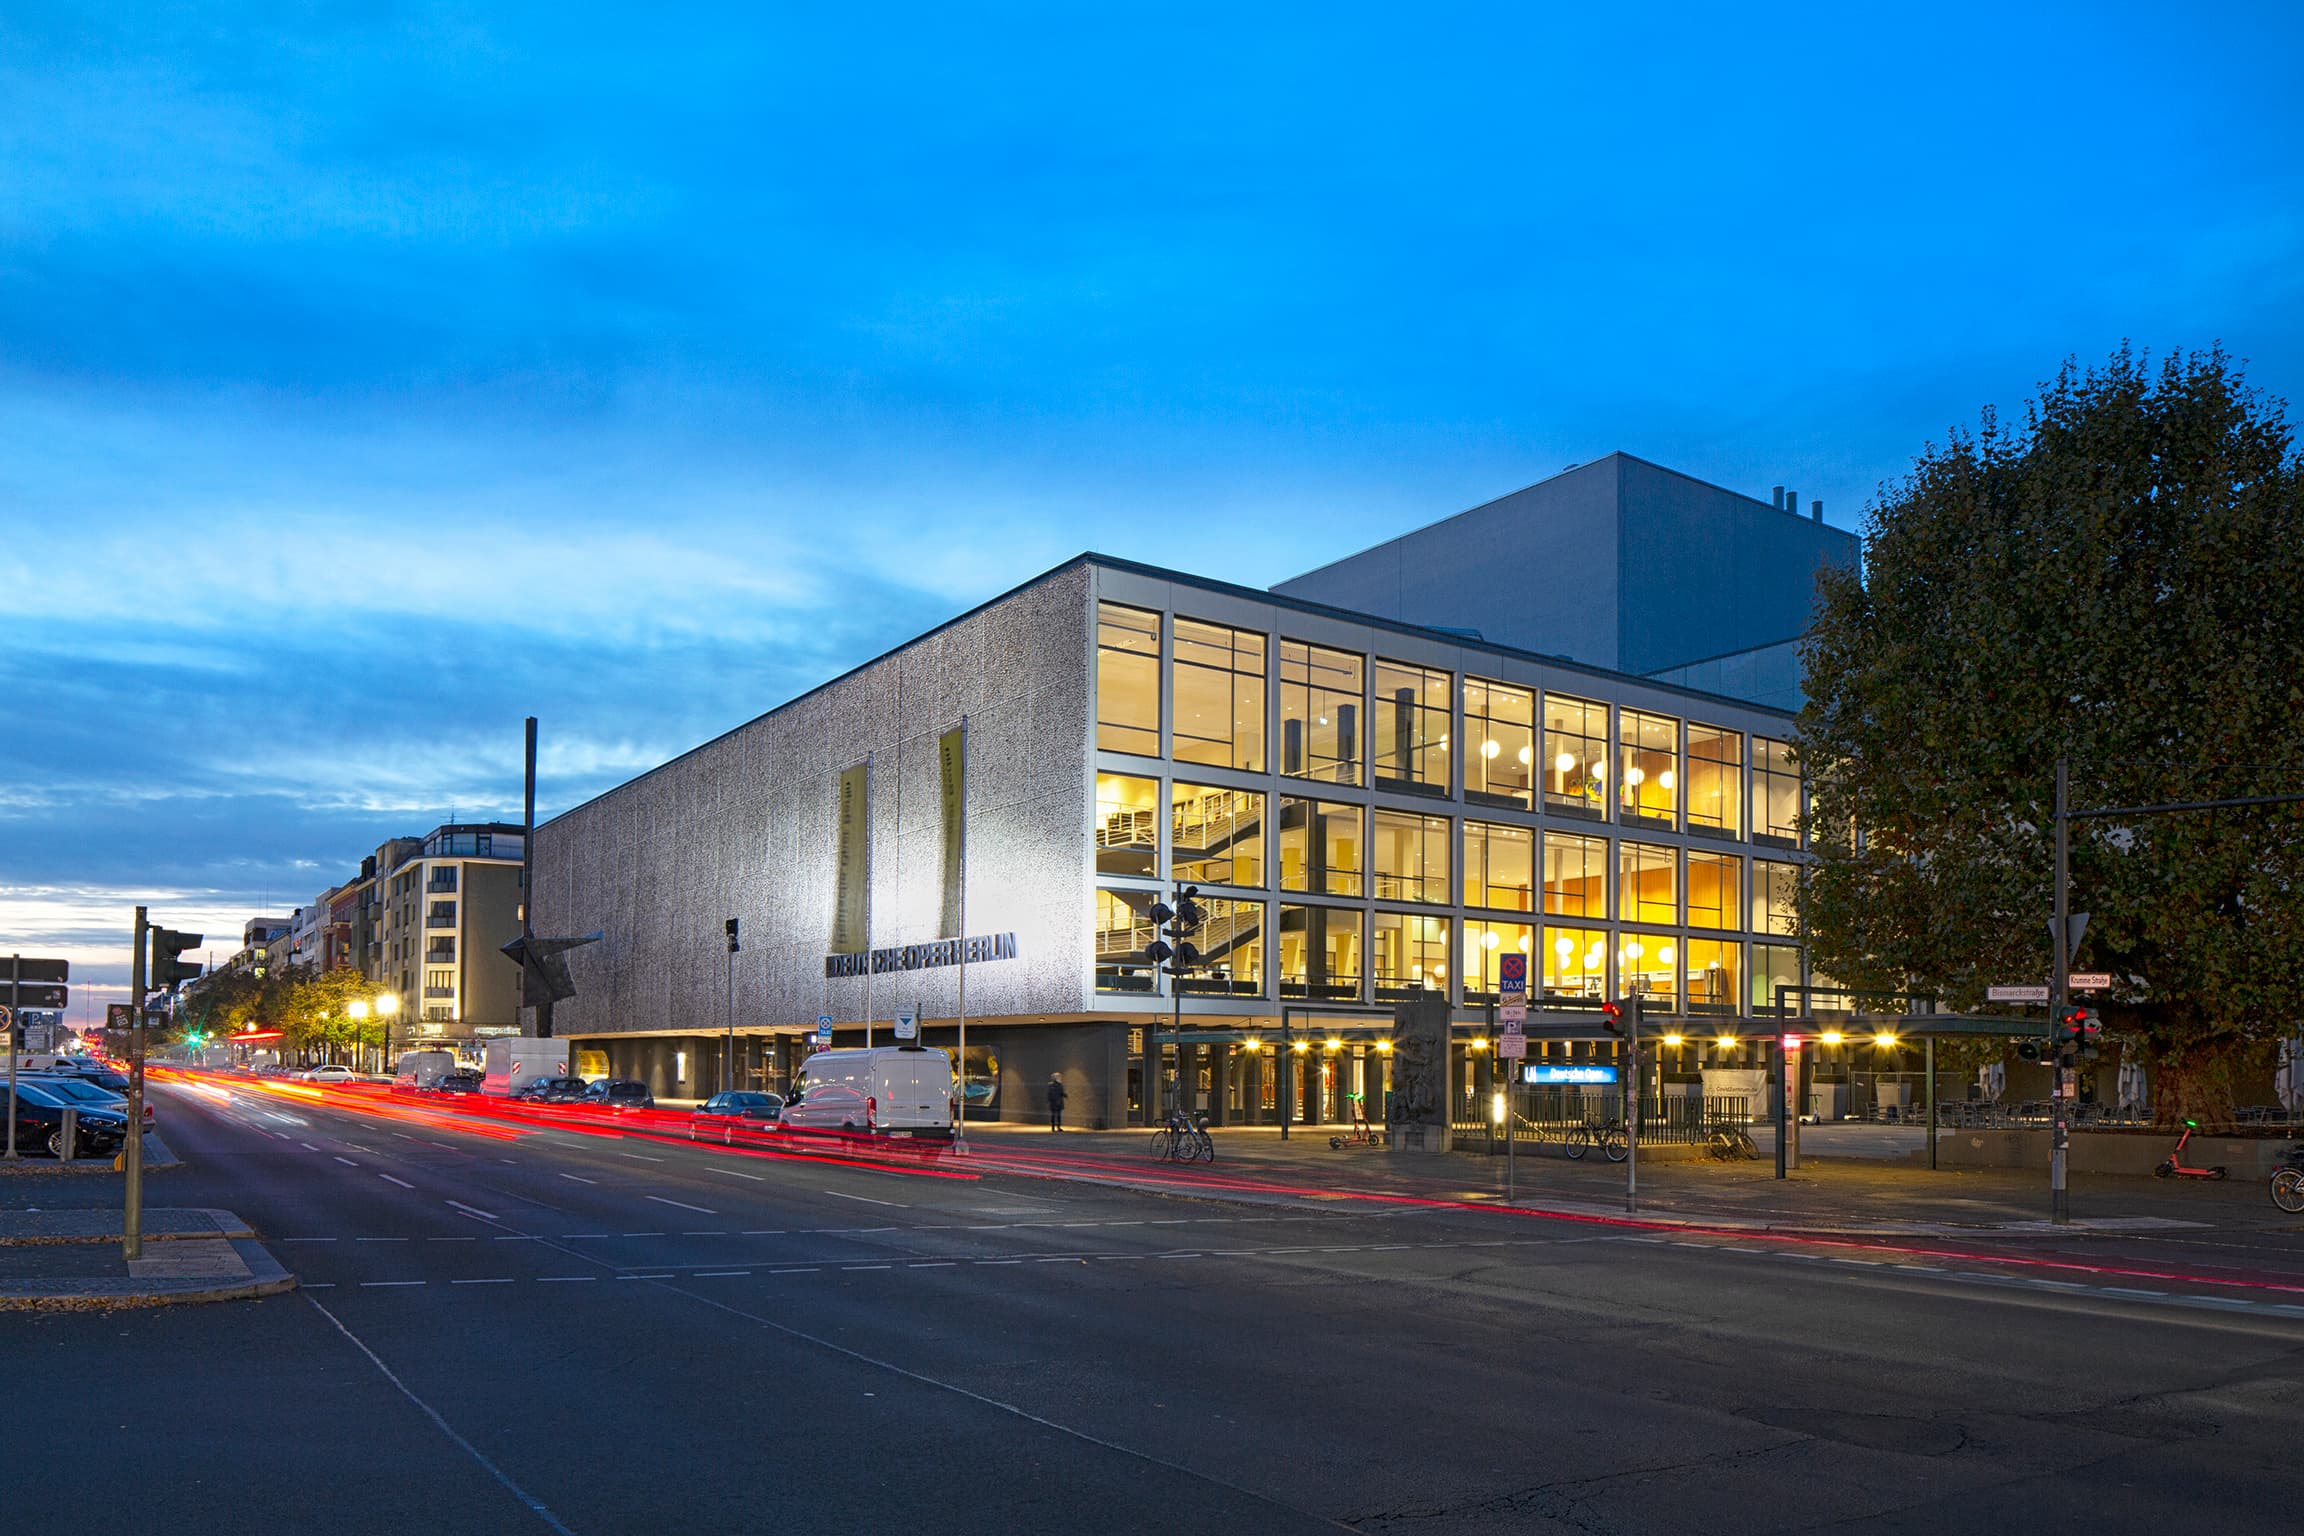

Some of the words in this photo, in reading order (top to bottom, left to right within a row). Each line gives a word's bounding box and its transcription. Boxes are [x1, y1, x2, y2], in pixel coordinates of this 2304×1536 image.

[906, 940, 952, 970] OPER
[953, 932, 1016, 964] BERLIN
[1503, 981, 1524, 990] TAXI
[1992, 988, 2045, 998] Bismarckstraße
[1550, 1067, 1584, 1080] Deutsche
[1585, 1067, 1603, 1082] Oper
